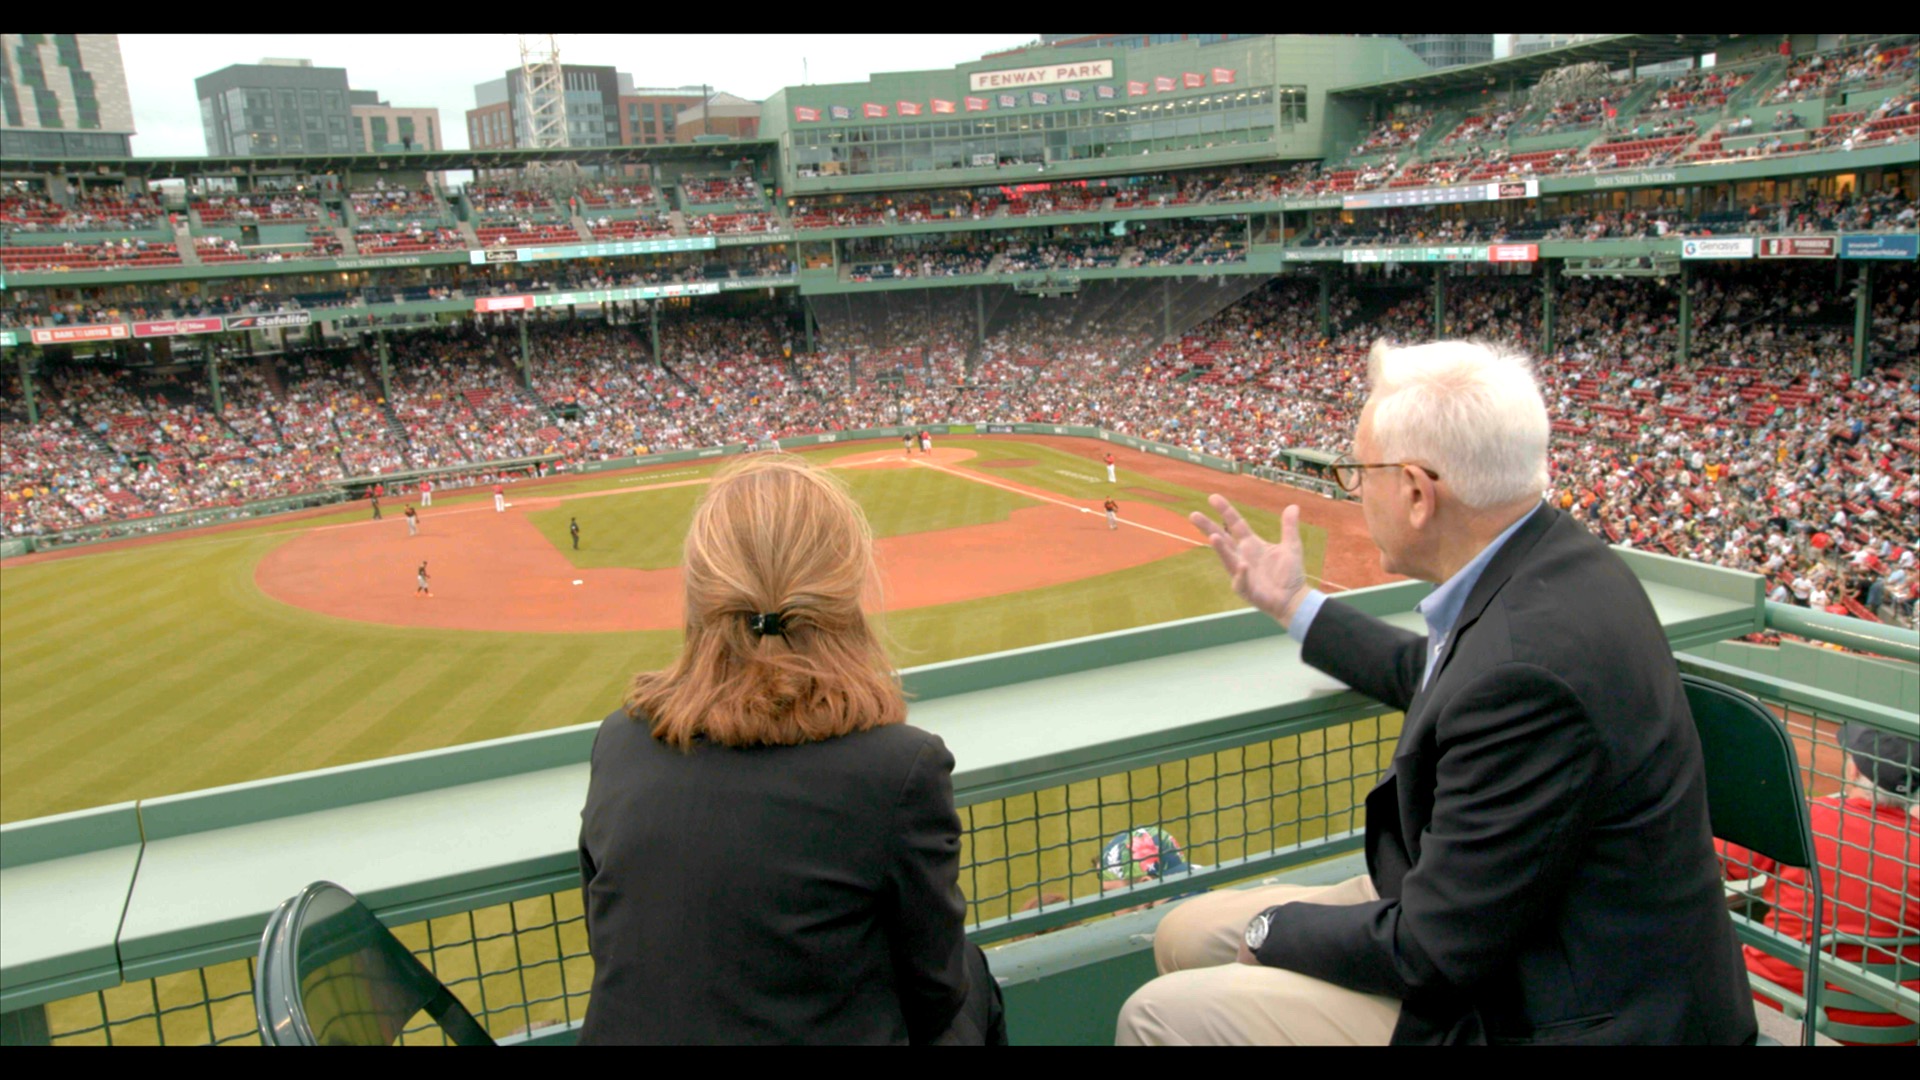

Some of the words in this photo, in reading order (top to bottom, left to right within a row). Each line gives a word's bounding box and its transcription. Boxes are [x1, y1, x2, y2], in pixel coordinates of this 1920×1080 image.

[979, 70, 1046, 87] FENWAY
[1057, 64, 1103, 79] PARK
[1699, 241, 1740, 251] Genasys
[360, 258, 384, 267] STREET
[386, 256, 420, 265] PAVILION
[256, 314, 309, 327] Safelite
